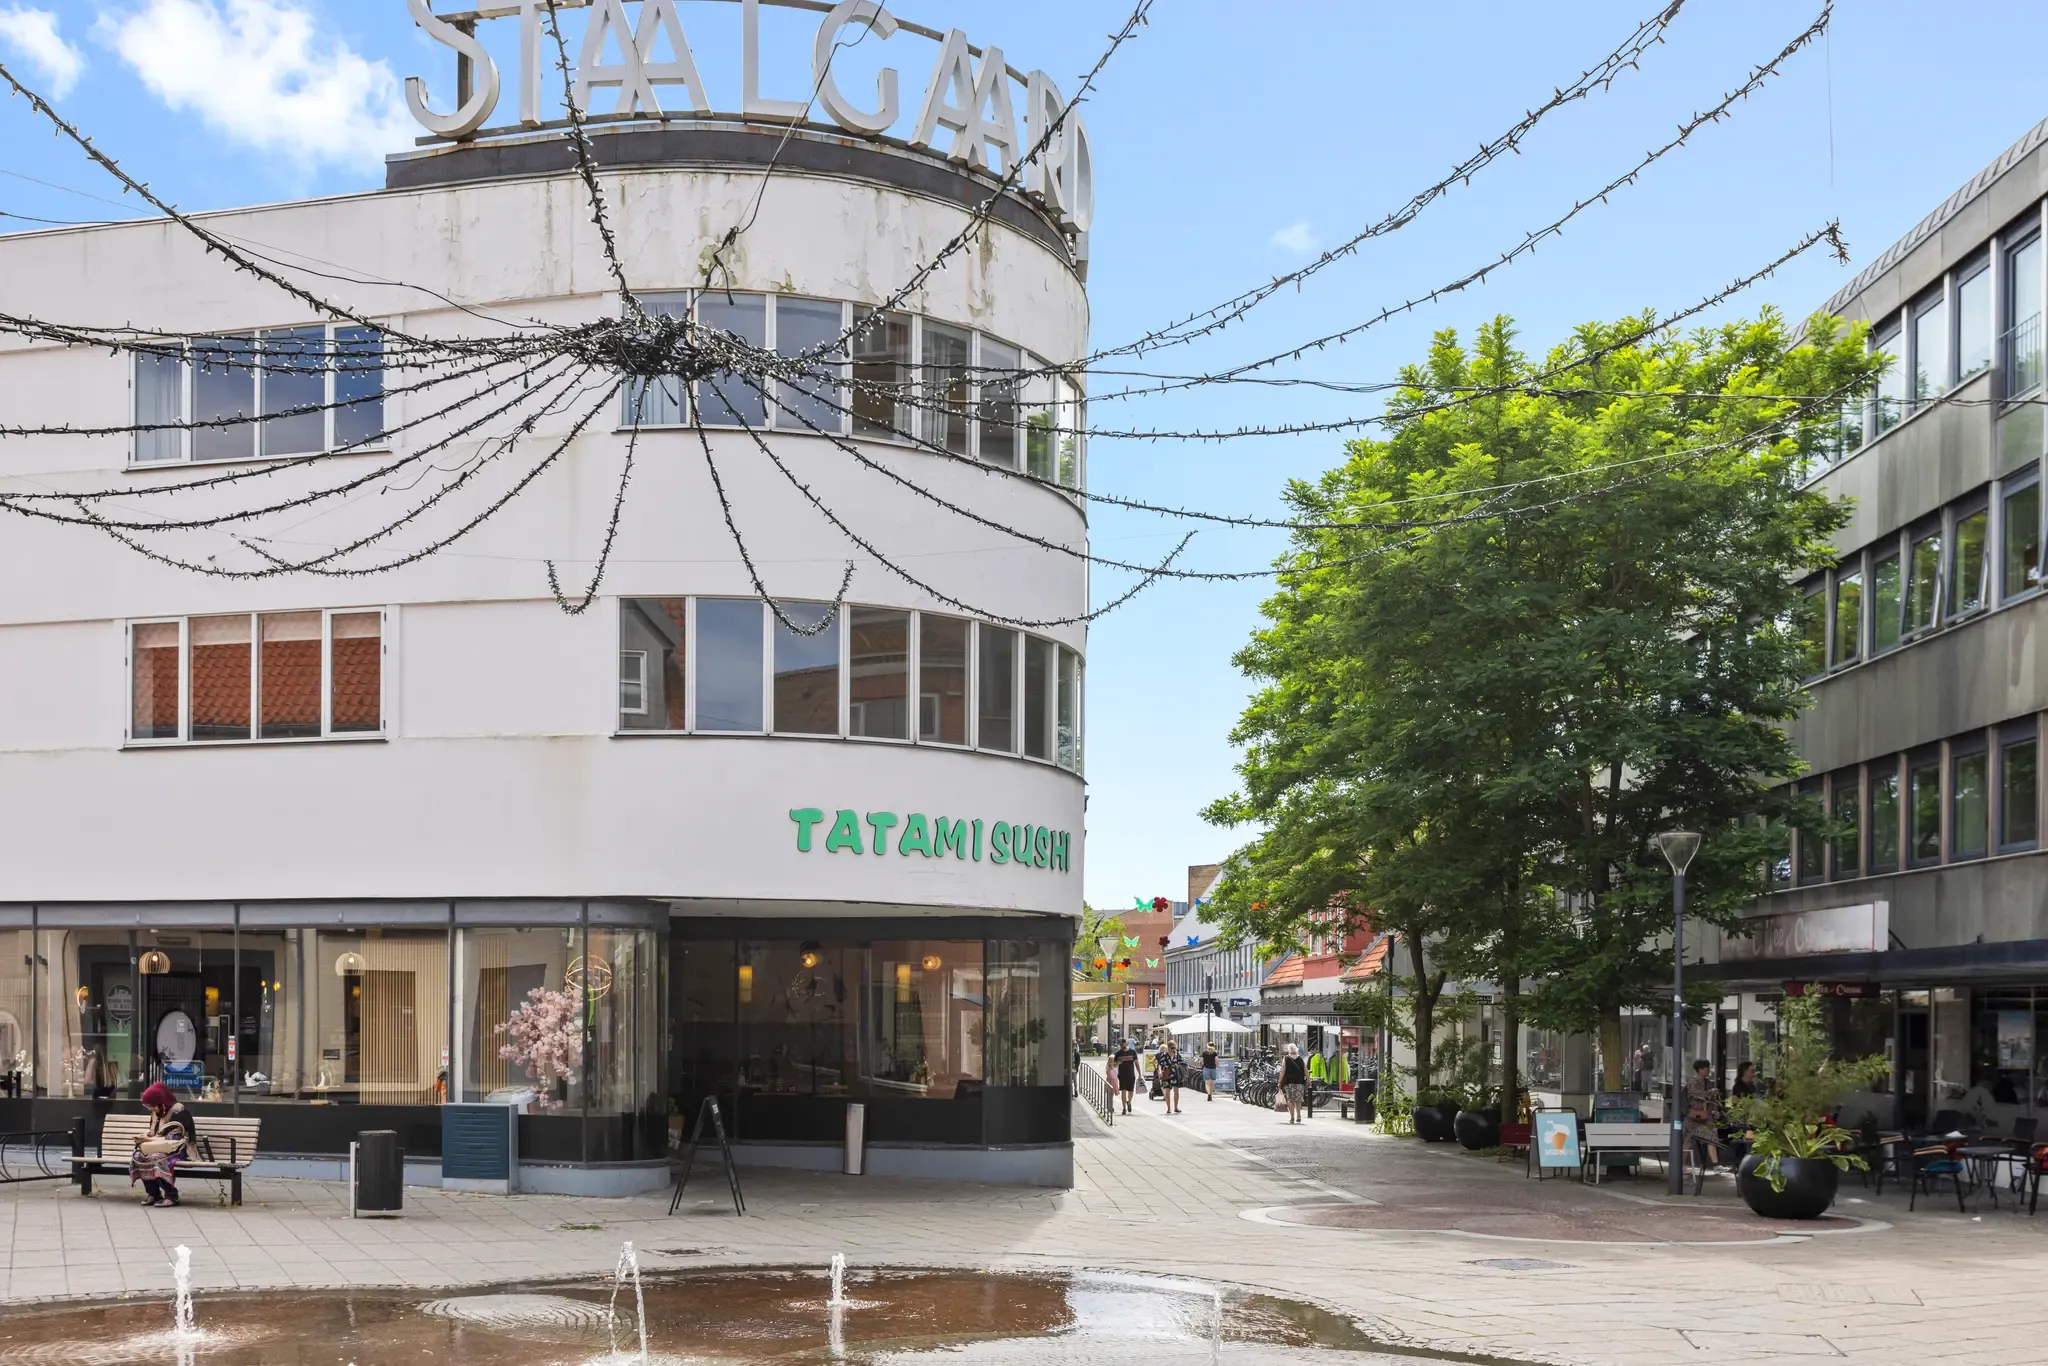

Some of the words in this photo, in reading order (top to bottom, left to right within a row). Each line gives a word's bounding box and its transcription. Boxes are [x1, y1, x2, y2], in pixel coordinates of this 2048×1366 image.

[405, 0, 1094, 233] STAALGAARD
[789, 807, 984, 862] TATAMI
[990, 820, 1071, 873] SUSHI
